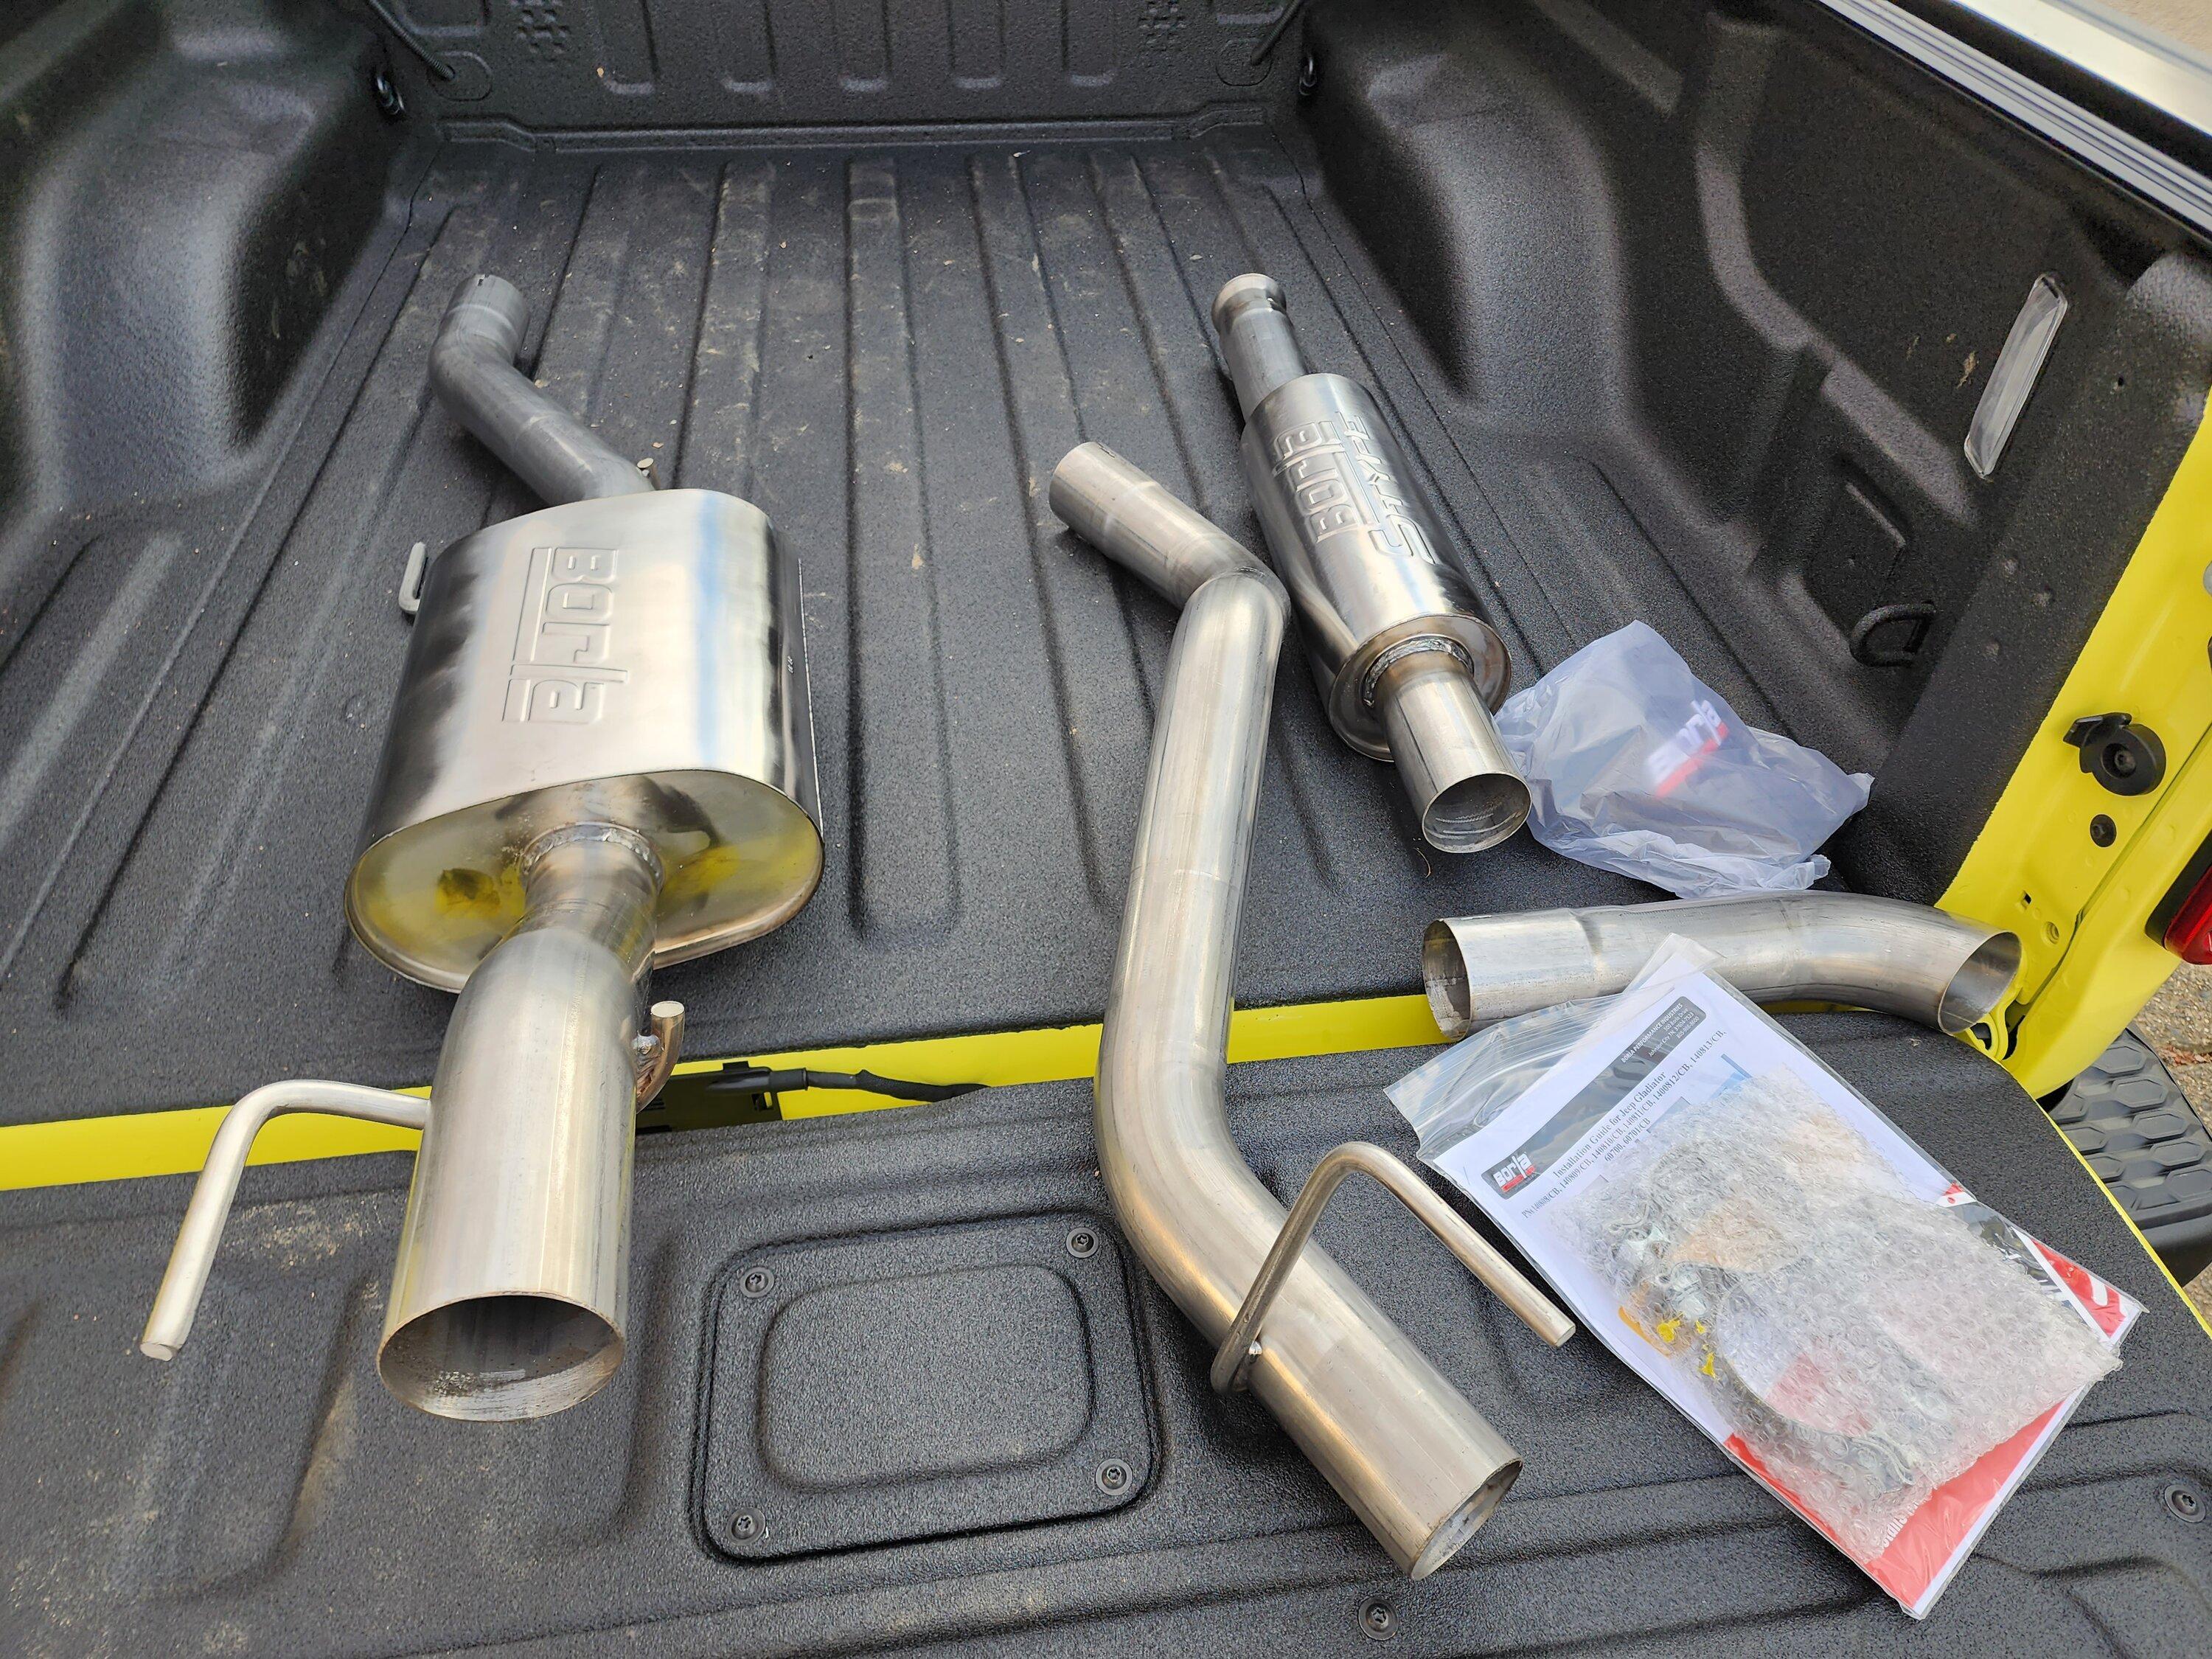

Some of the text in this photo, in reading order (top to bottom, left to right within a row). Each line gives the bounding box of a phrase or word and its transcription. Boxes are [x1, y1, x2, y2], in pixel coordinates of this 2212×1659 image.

[1621, 1002, 1683, 1062] BORLA PERFORMANCE INDUSTRIES
[1552, 1070, 1667, 1179] Installation Guide for Jeep Gladiator
[1603, 1116, 1651, 1163] 60700, 60701/CB
